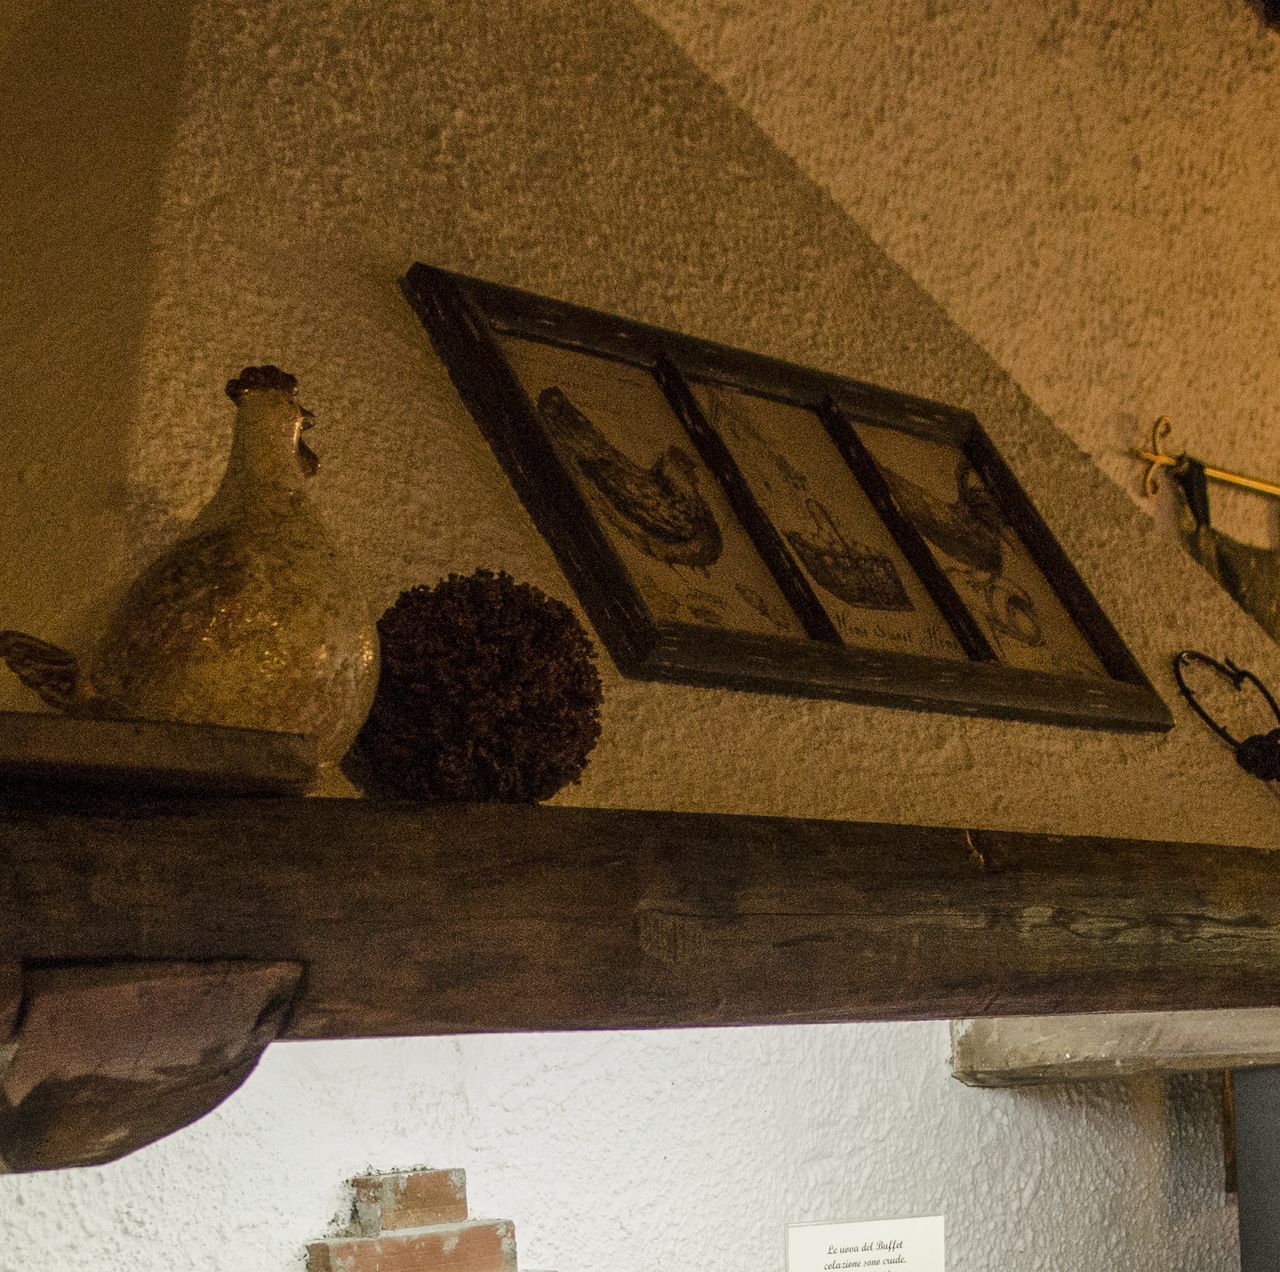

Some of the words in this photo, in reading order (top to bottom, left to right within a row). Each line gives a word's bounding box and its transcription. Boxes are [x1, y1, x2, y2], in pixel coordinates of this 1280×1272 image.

[827, 1243, 837, 1254] Le
[840, 1245, 859, 1254] uova
[861, 1241, 873, 1252] del
[876, 1239, 903, 1252] Buffet
[824, 1259, 861, 1270] colazione
[863, 1259, 881, 1267] sono
[882, 1254, 906, 1265] crude.
